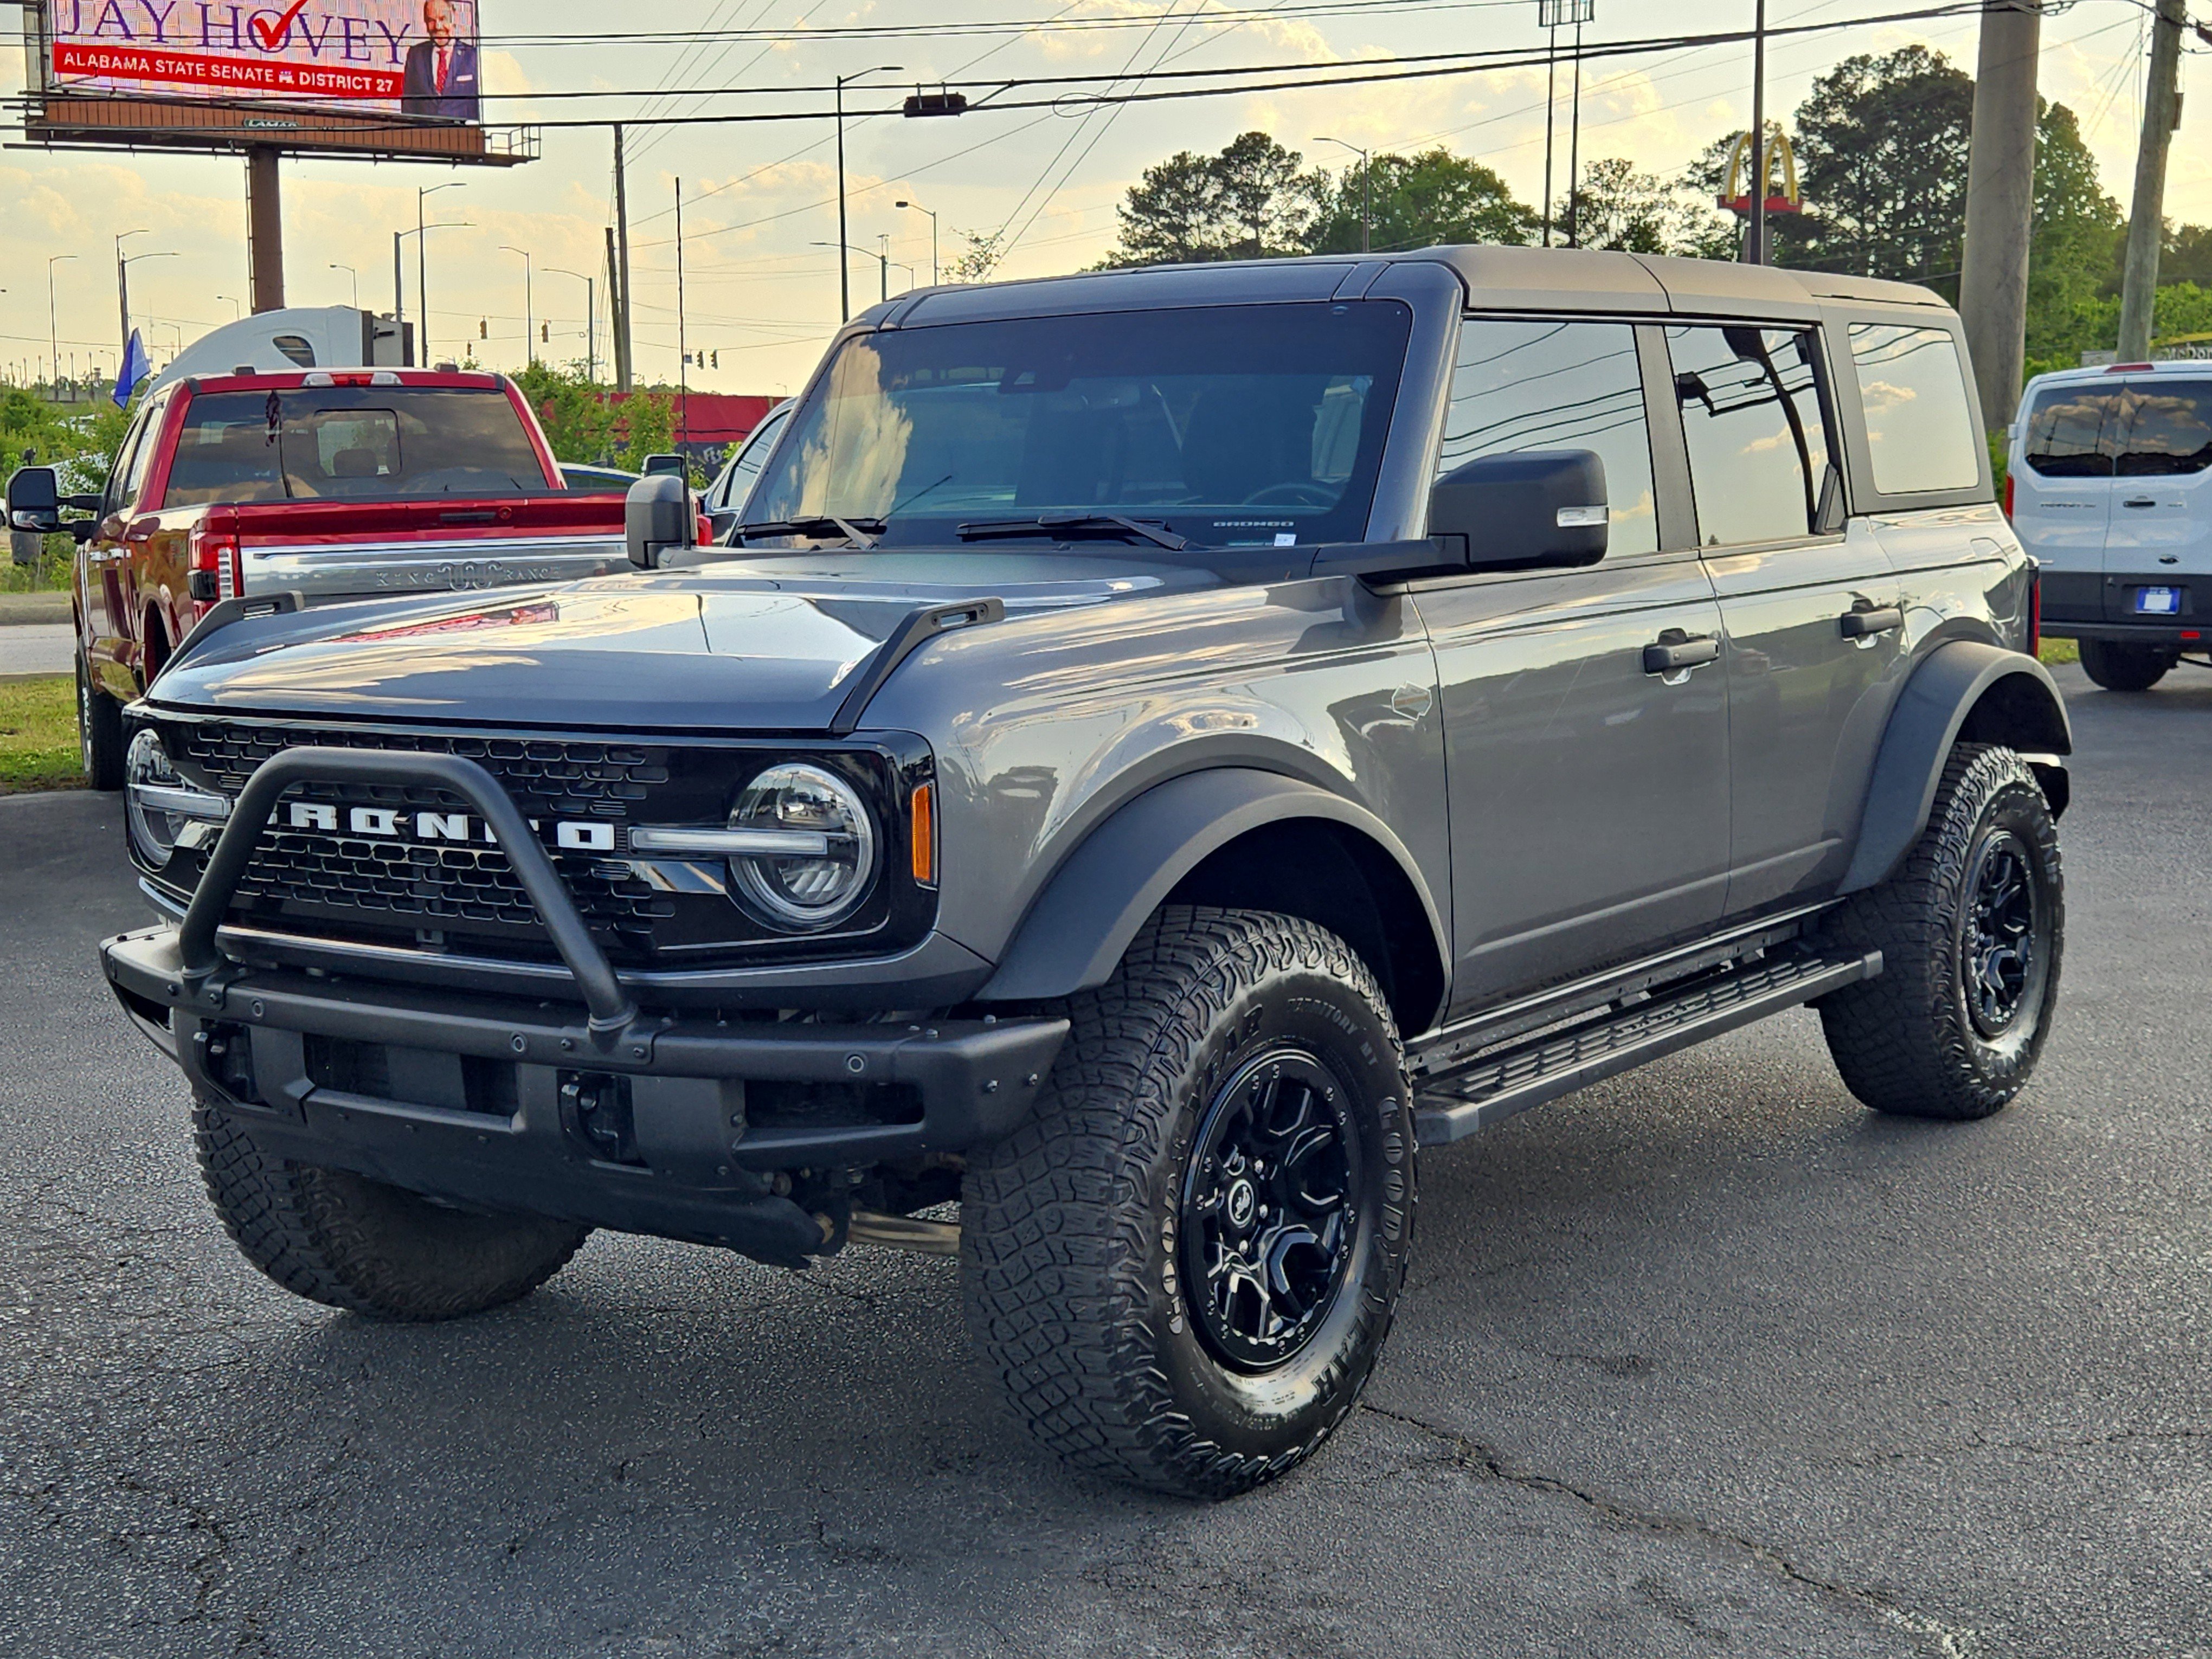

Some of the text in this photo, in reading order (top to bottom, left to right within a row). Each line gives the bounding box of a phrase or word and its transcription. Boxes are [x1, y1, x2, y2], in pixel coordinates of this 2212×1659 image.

[61, 0, 411, 65] JAY HOVEY
[63, 52, 394, 92] ALABAMA STATE SENATE DISTRICT 27
[376, 571, 434, 587] KING
[266, 801, 614, 850] RONO
